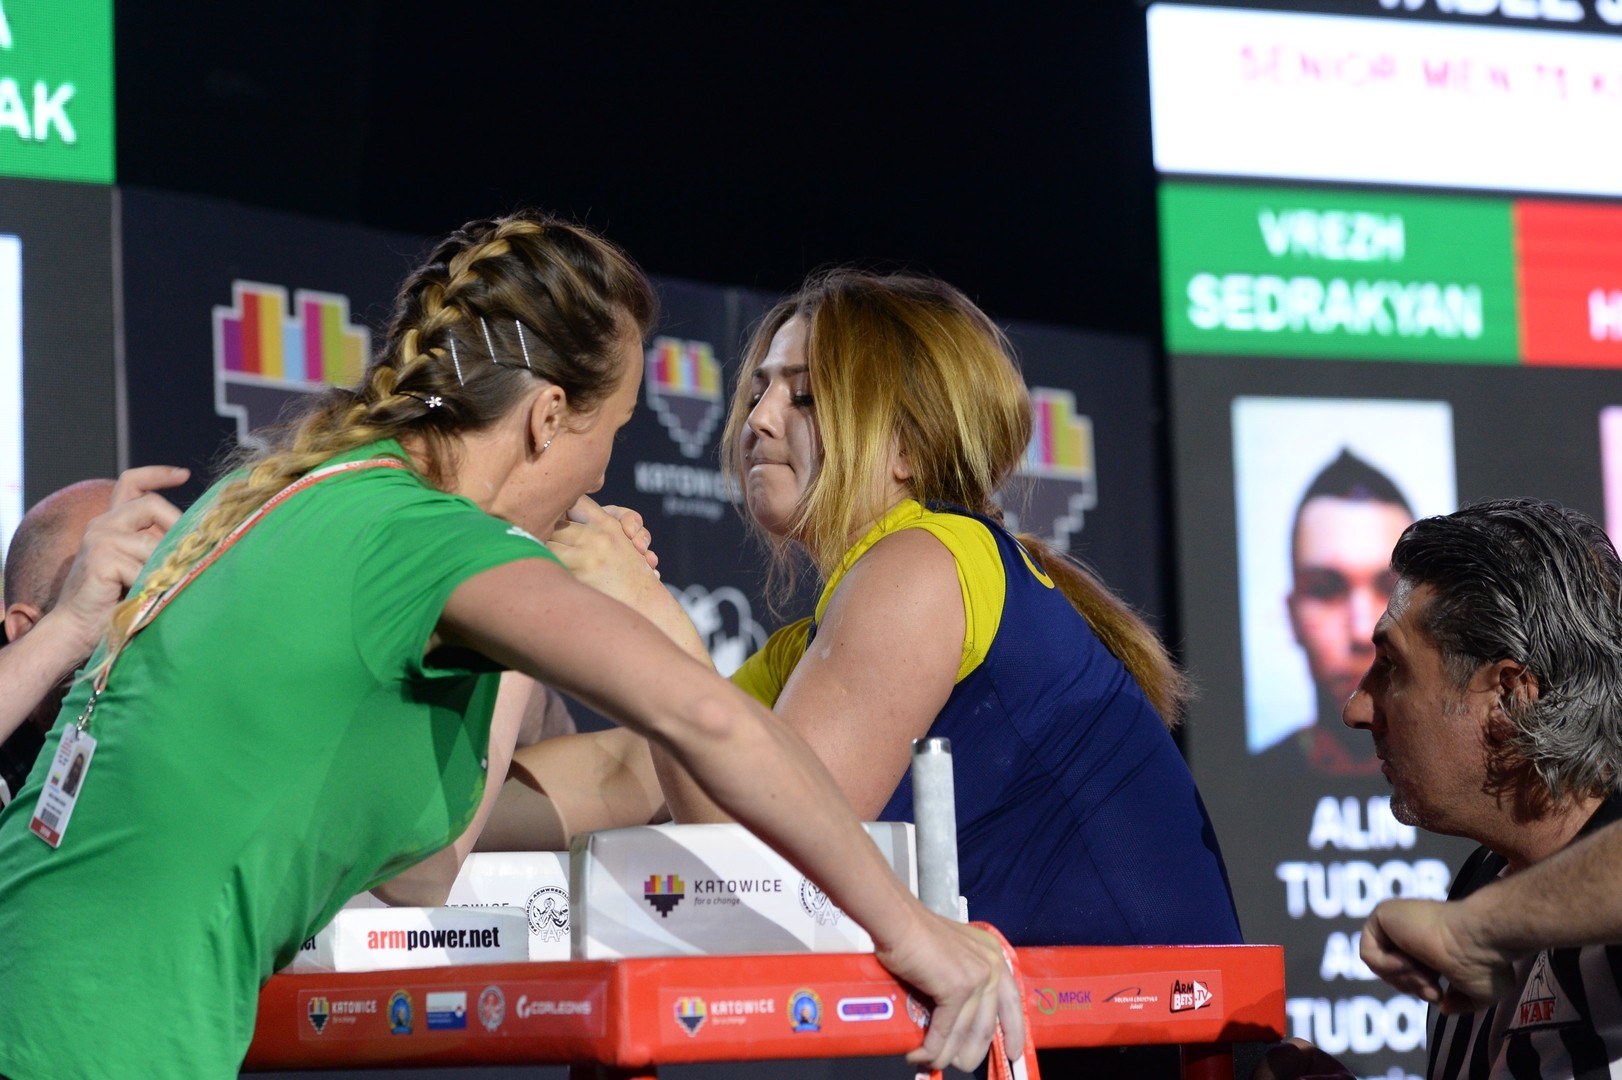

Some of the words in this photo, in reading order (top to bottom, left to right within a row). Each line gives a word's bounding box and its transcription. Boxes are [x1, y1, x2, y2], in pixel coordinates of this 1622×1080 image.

[1258, 208, 1404, 261] VREZH
[1187, 273, 1482, 339] SEDRAKYAN
[1308, 795, 1417, 850] ALIN
[695, 880, 782, 893] KATOWICE
[1276, 859, 1452, 919] TUDOR
[367, 926, 500, 951] armpower.net
[1059, 991, 1091, 1004] MPGK
[1173, 980, 1194, 994] ARM
[332, 1000, 377, 1015] KATOWICE
[711, 999, 775, 1016] KATOWICE
[1174, 994, 1193, 1010] BETS
[1520, 1000, 1555, 1024] WAF
[1286, 993, 1428, 1055] TUDO
